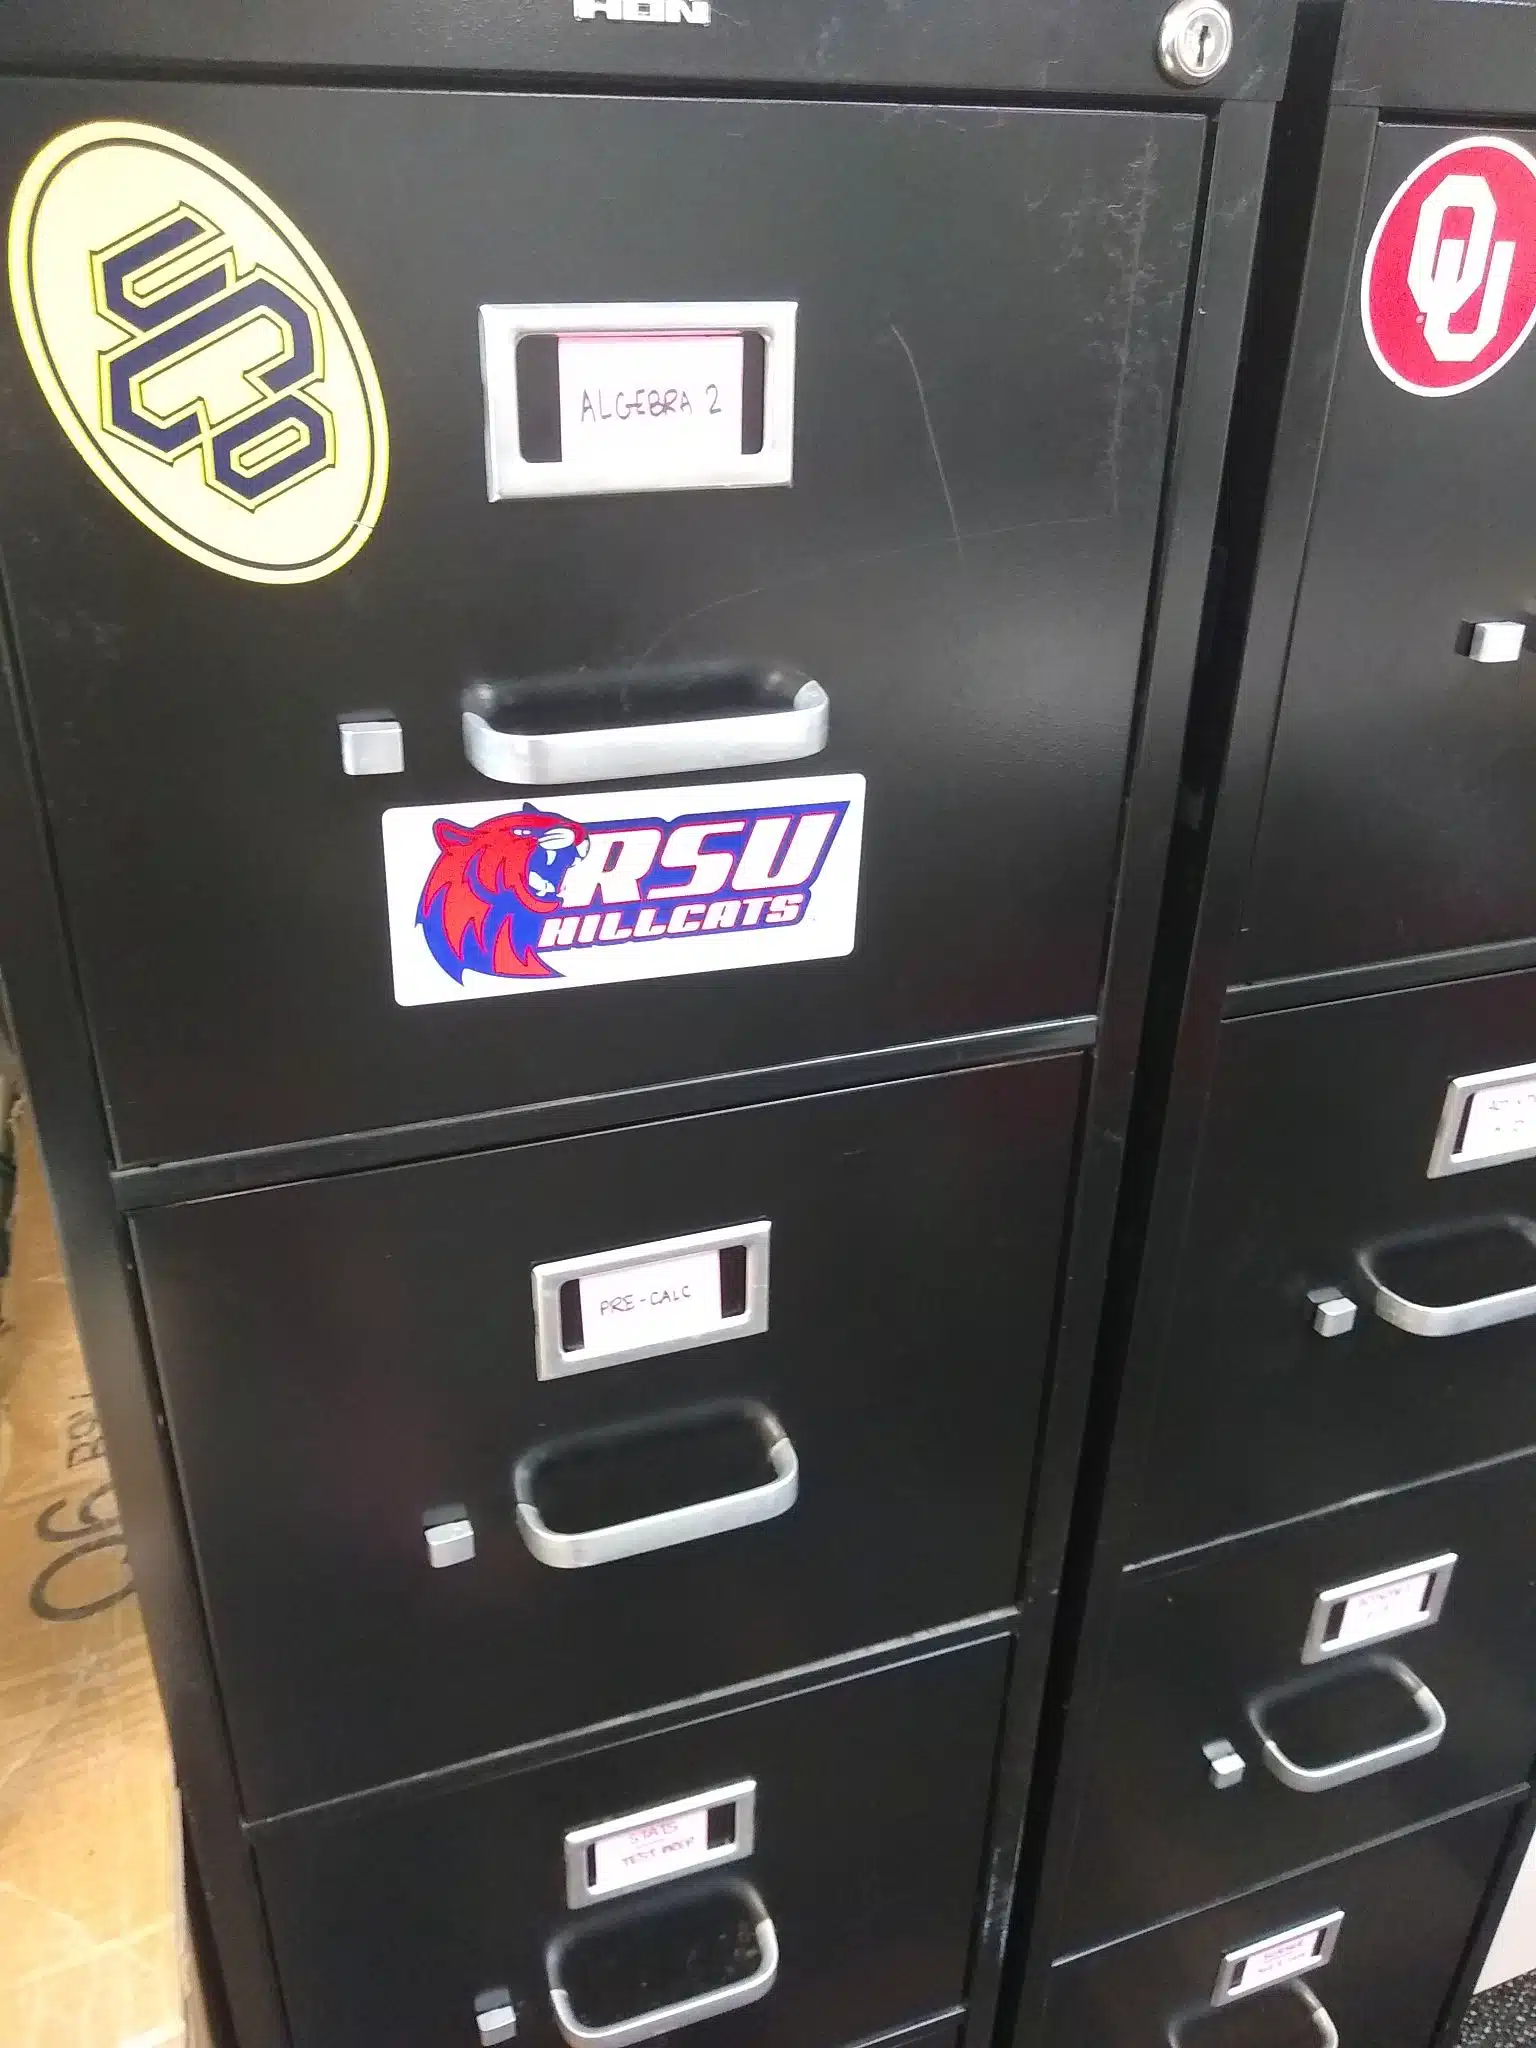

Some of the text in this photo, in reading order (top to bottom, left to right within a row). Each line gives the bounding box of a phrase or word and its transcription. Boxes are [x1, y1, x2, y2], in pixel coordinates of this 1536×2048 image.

[573, 0, 712, 26] HON
[1407, 174, 1516, 362] OU
[92, 203, 335, 510] UCO
[578, 383, 722, 422] ALGEBRA 2
[557, 810, 839, 909] RSU
[536, 893, 804, 949] HILLCATS
